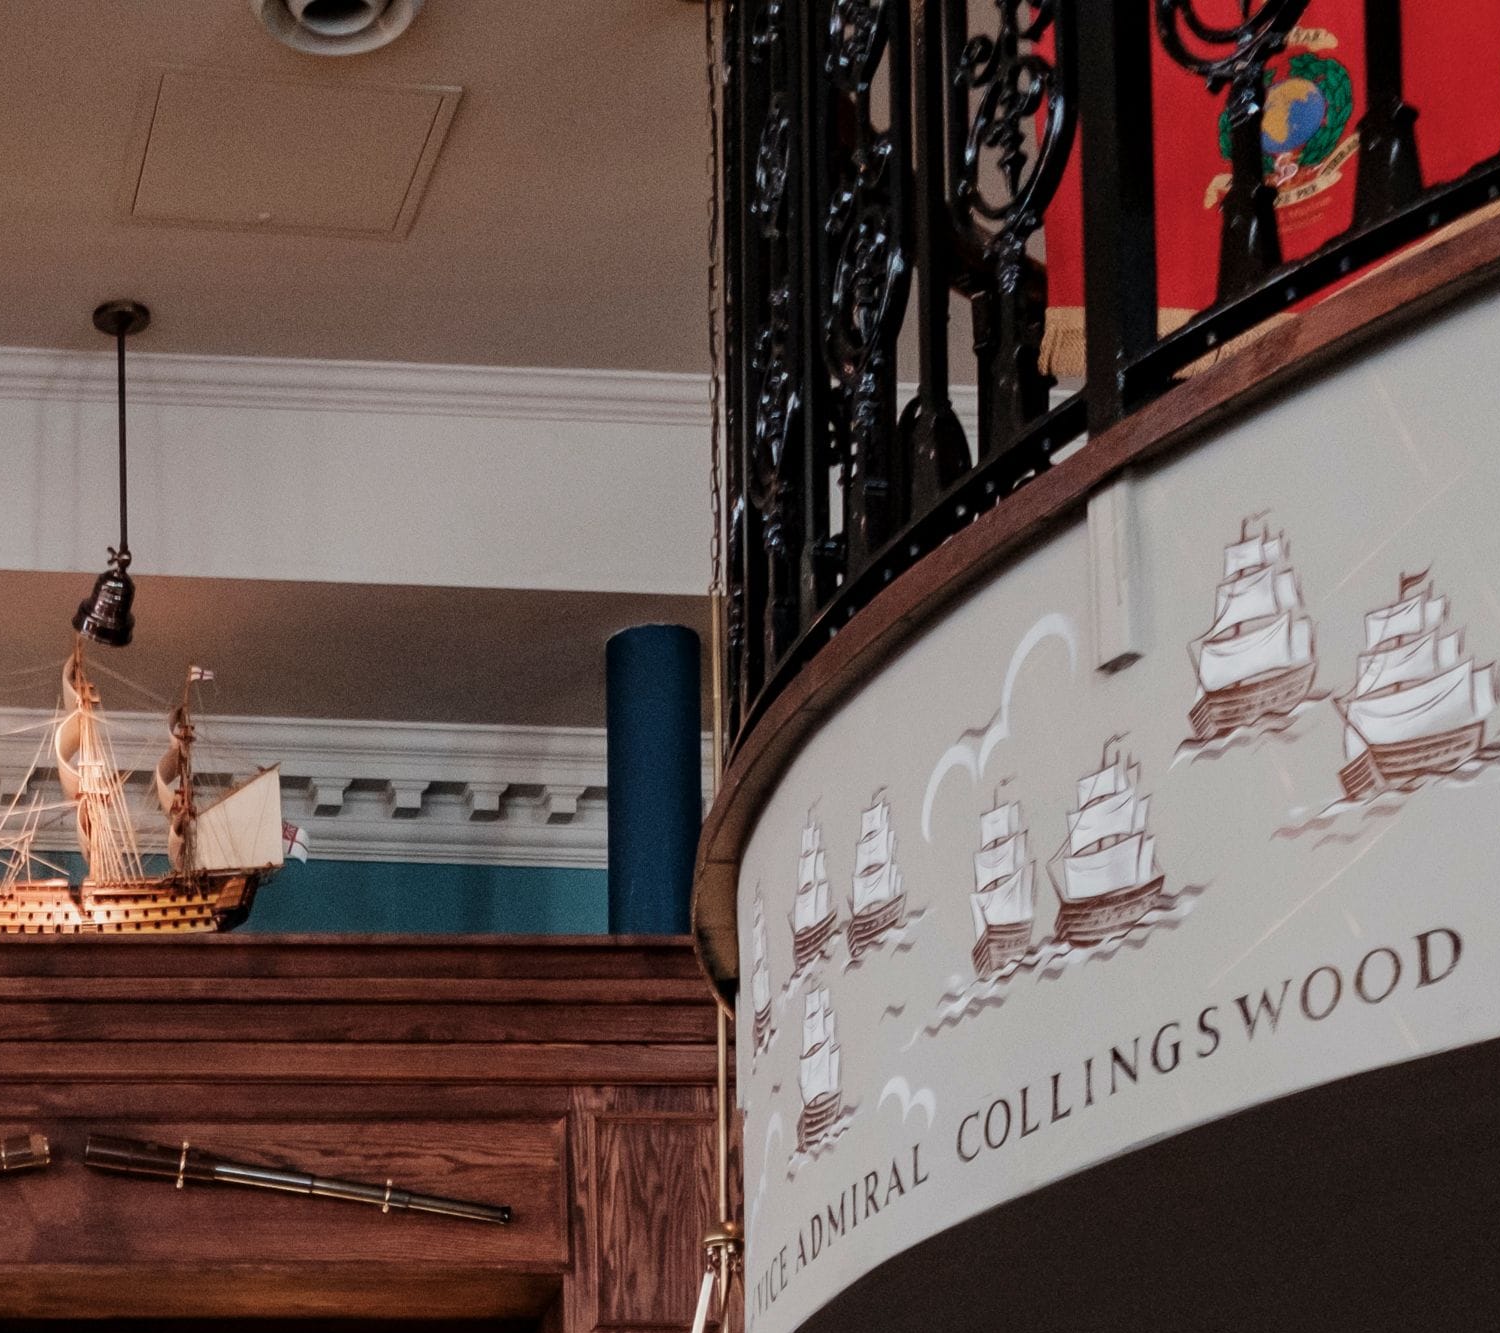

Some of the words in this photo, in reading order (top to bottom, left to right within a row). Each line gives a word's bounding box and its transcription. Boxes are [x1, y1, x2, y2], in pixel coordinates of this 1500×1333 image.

[755, 1244, 790, 1316] VICE
[794, 1141, 930, 1273] ADMIRAL
[954, 926, 1466, 1164] COLLINGSWOOD
